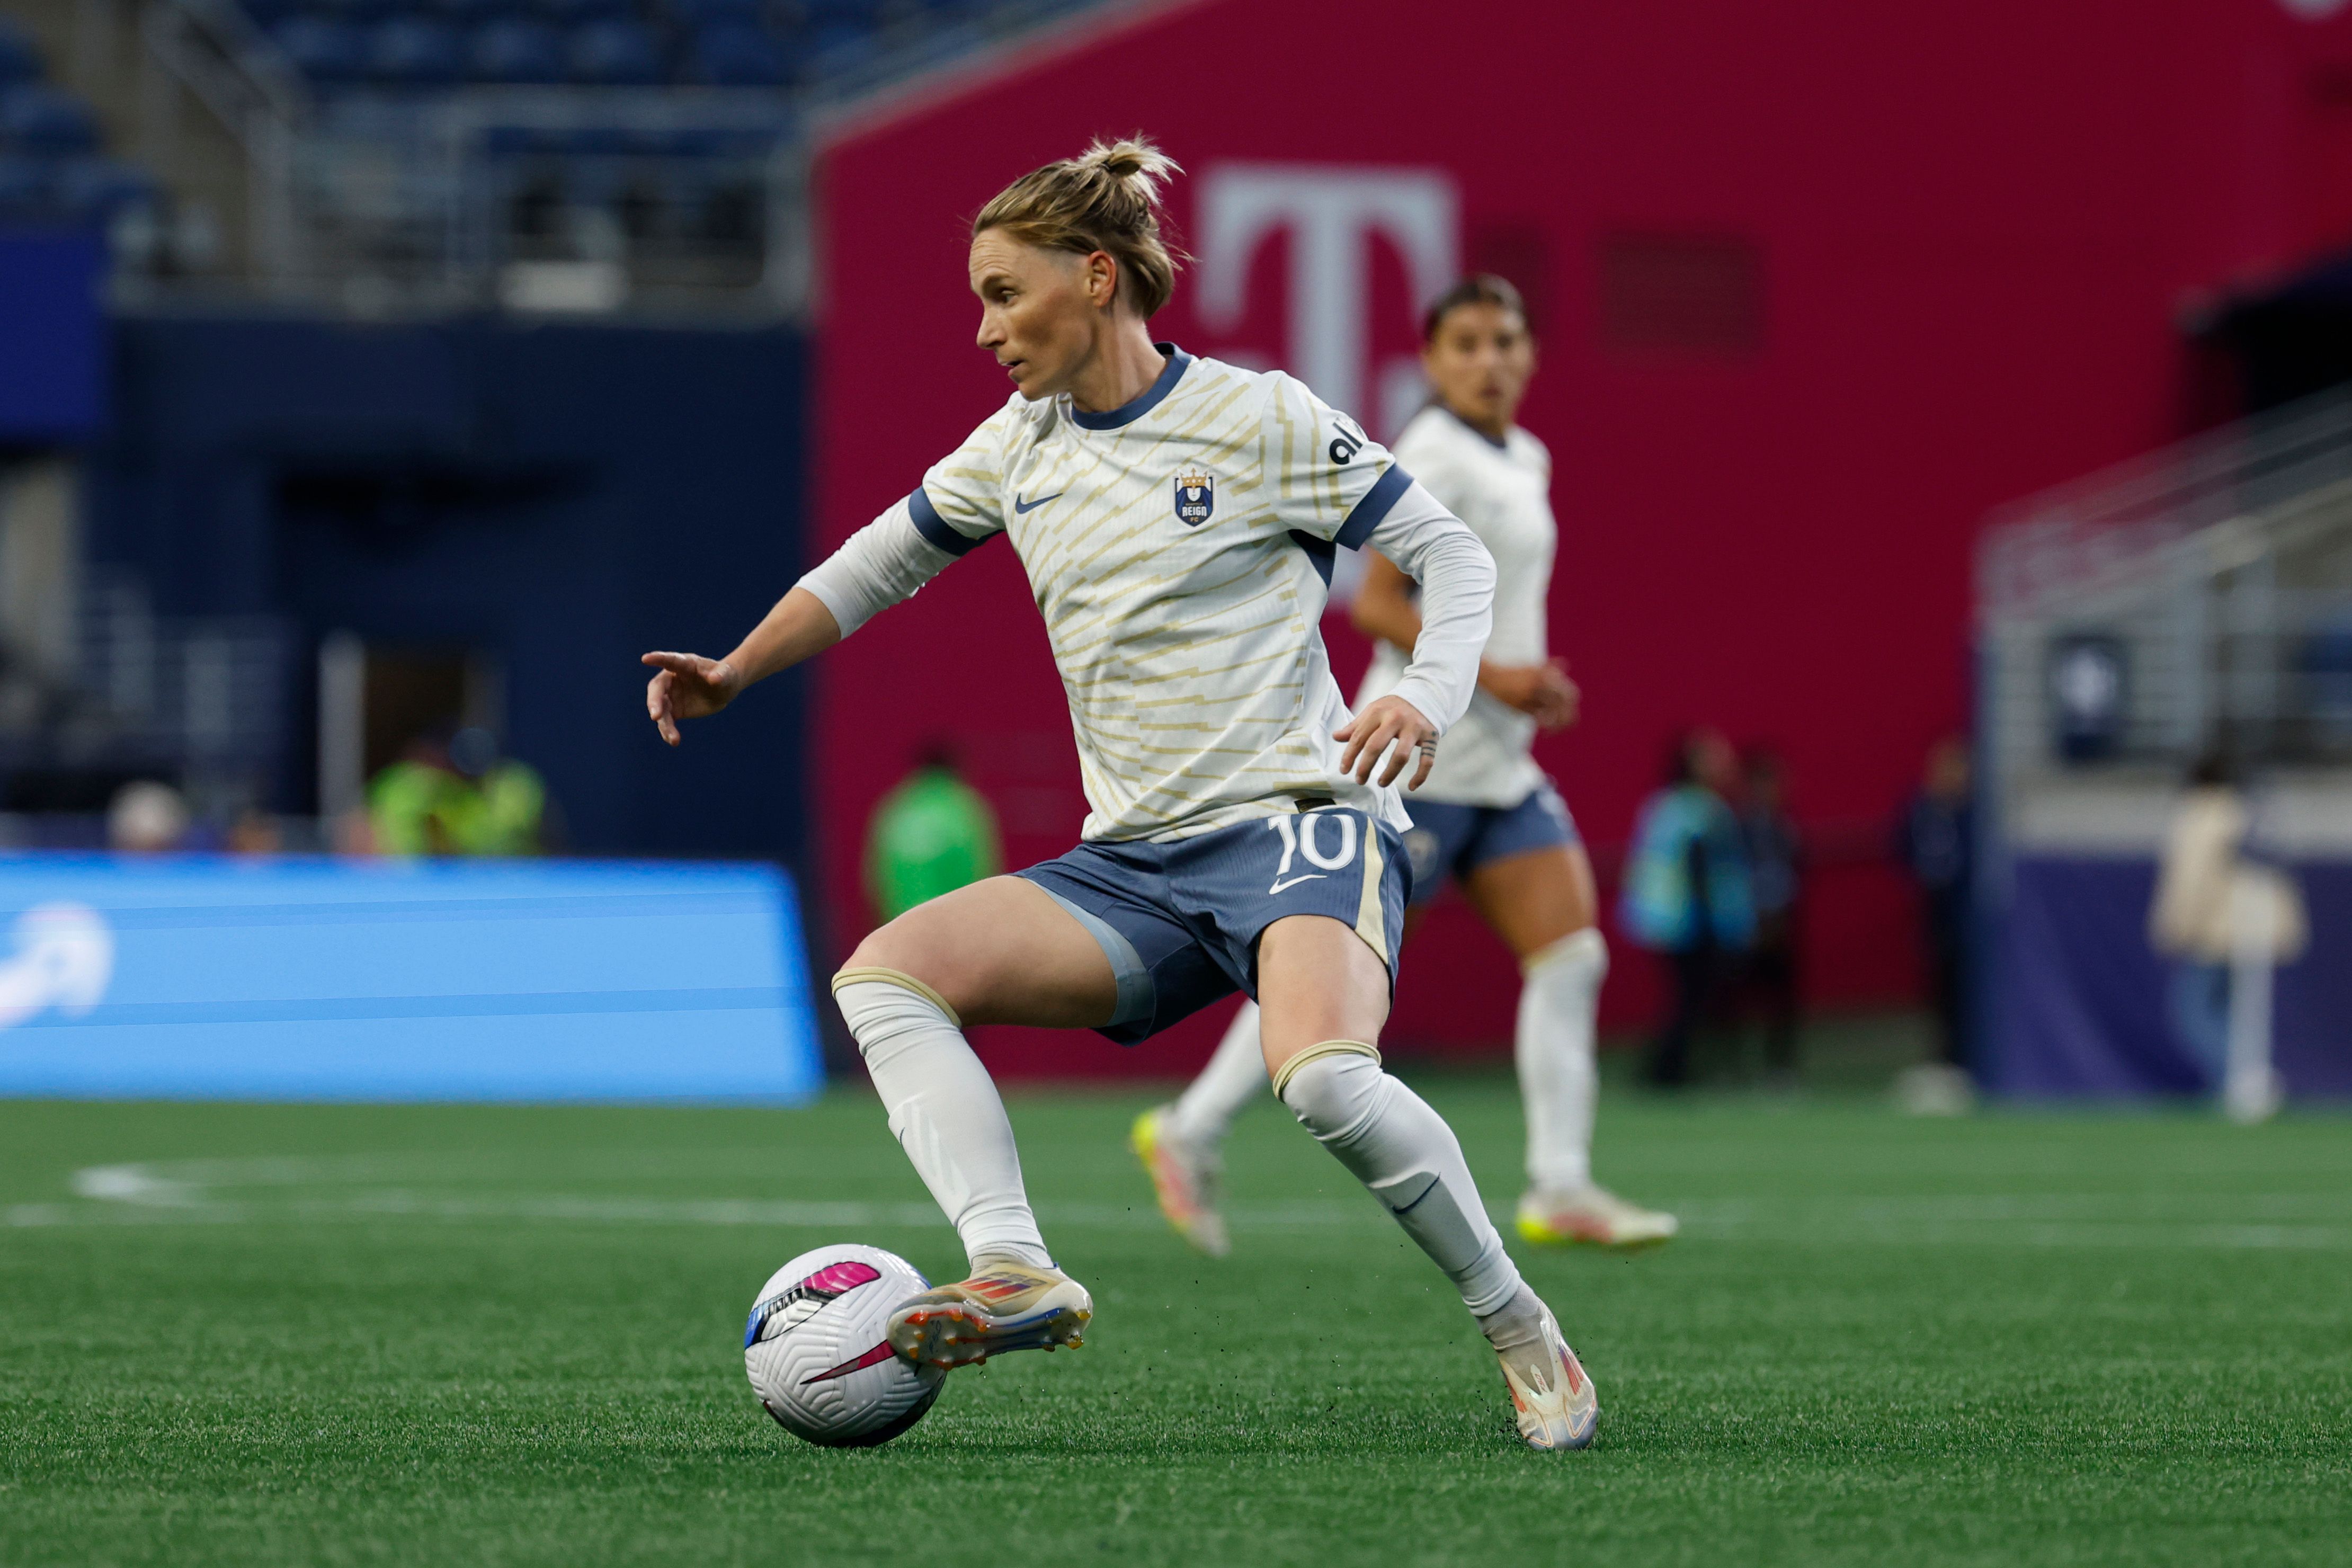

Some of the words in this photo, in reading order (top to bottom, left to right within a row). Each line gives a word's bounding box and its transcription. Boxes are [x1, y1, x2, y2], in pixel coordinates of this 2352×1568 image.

[1199, 165, 1457, 435] T
[1330, 417, 1364, 465] al
[1182, 506, 1207, 517] REIGN
[1268, 813, 1357, 876] 10
